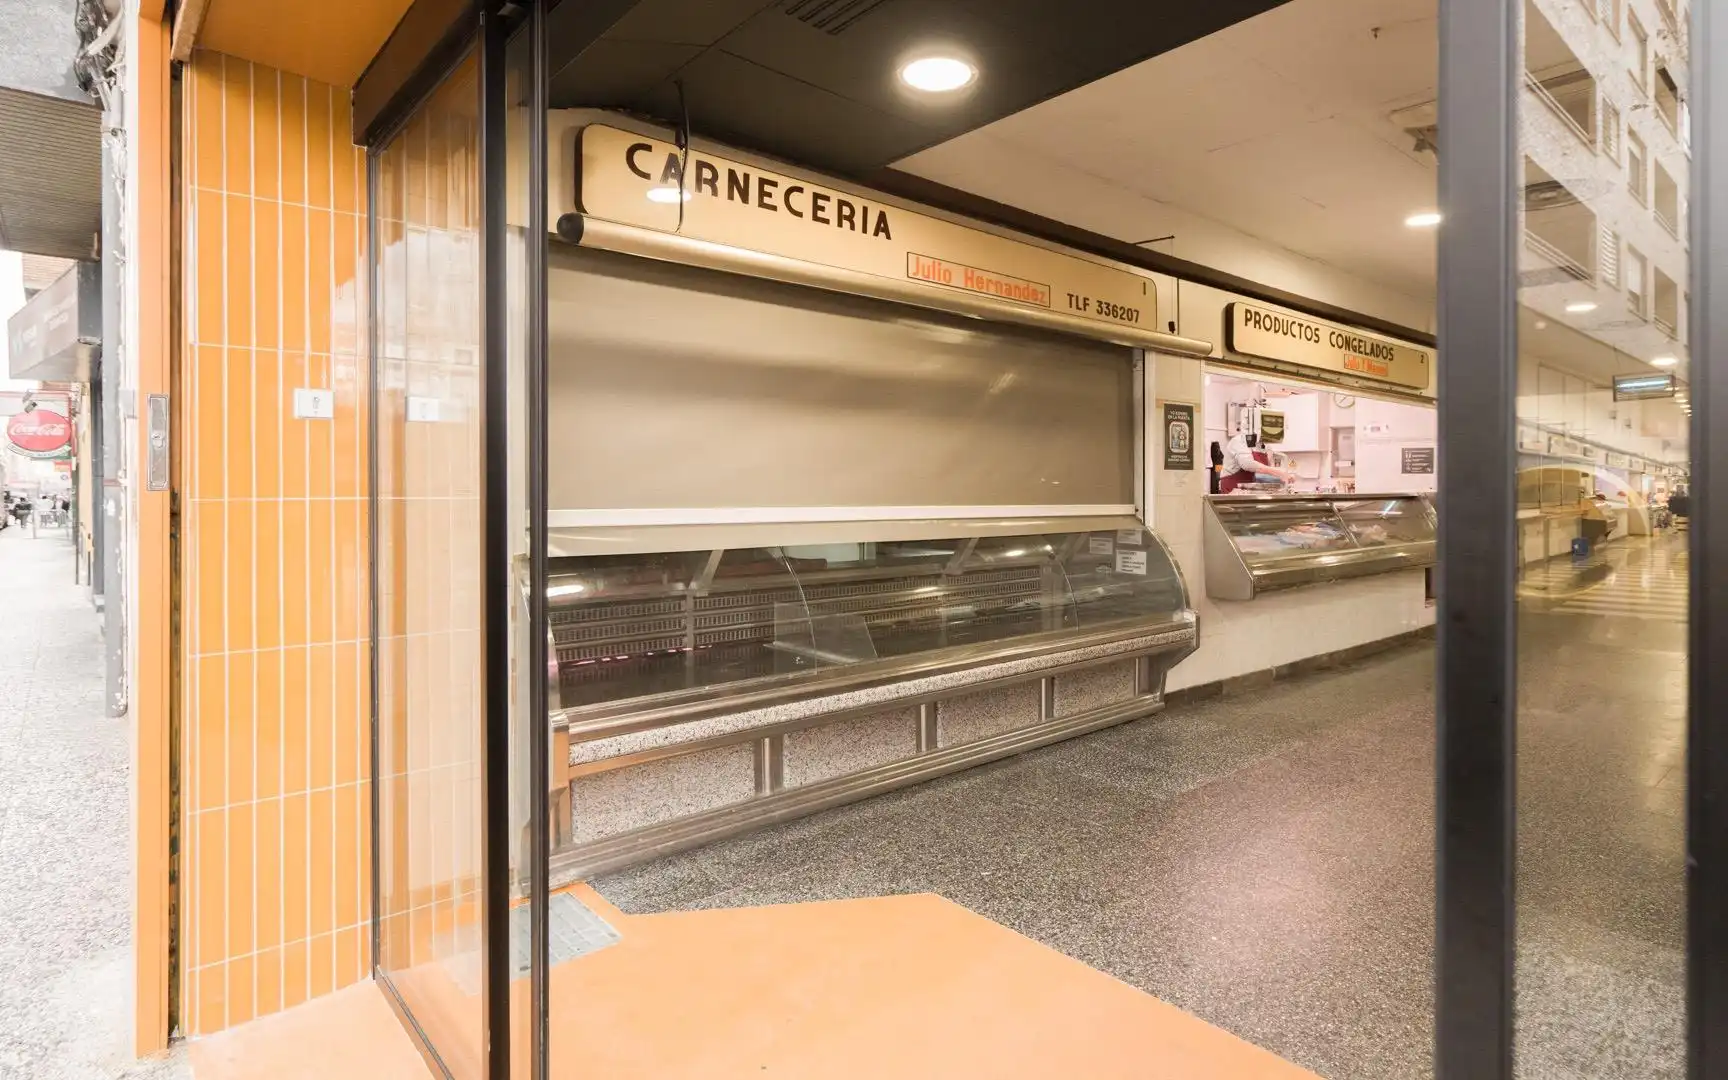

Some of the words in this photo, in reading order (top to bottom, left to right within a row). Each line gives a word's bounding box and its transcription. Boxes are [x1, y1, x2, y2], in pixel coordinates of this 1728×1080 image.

[625, 142, 892, 241] CARNECERIA
[912, 256, 952, 284] Julio
[963, 267, 1047, 303] Hernandez
[1066, 292, 1091, 312] TLF
[1096, 299, 1140, 323] 336207
[1244, 308, 1321, 344] PRODUCTOS
[1329, 331, 1395, 362] CONGELADOS
